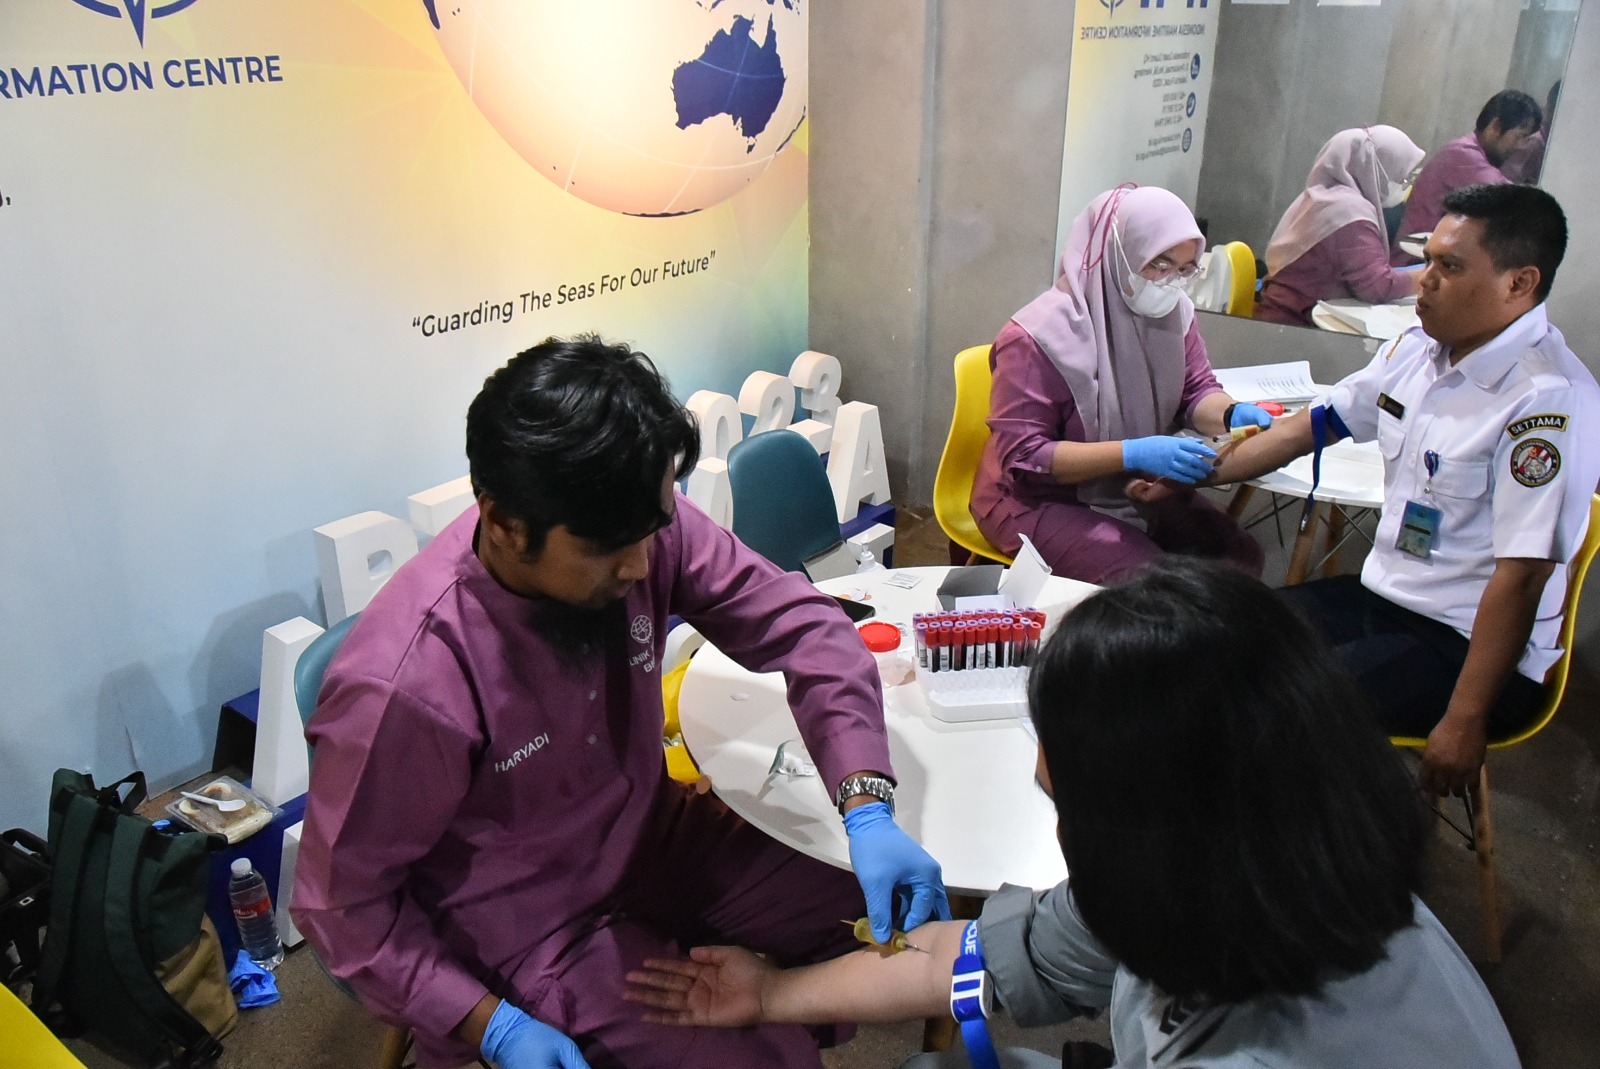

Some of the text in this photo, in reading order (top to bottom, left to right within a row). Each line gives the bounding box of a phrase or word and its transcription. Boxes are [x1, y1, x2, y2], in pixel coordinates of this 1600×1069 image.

[163, 55, 284, 89] CENTRE
[520, 292, 552, 314] The
[557, 281, 595, 305] Seas
[600, 274, 626, 295] For
[630, 267, 658, 288] Our
[1511, 416, 1561, 434] SETTAMA
[494, 732, 550, 773] HARYADI
